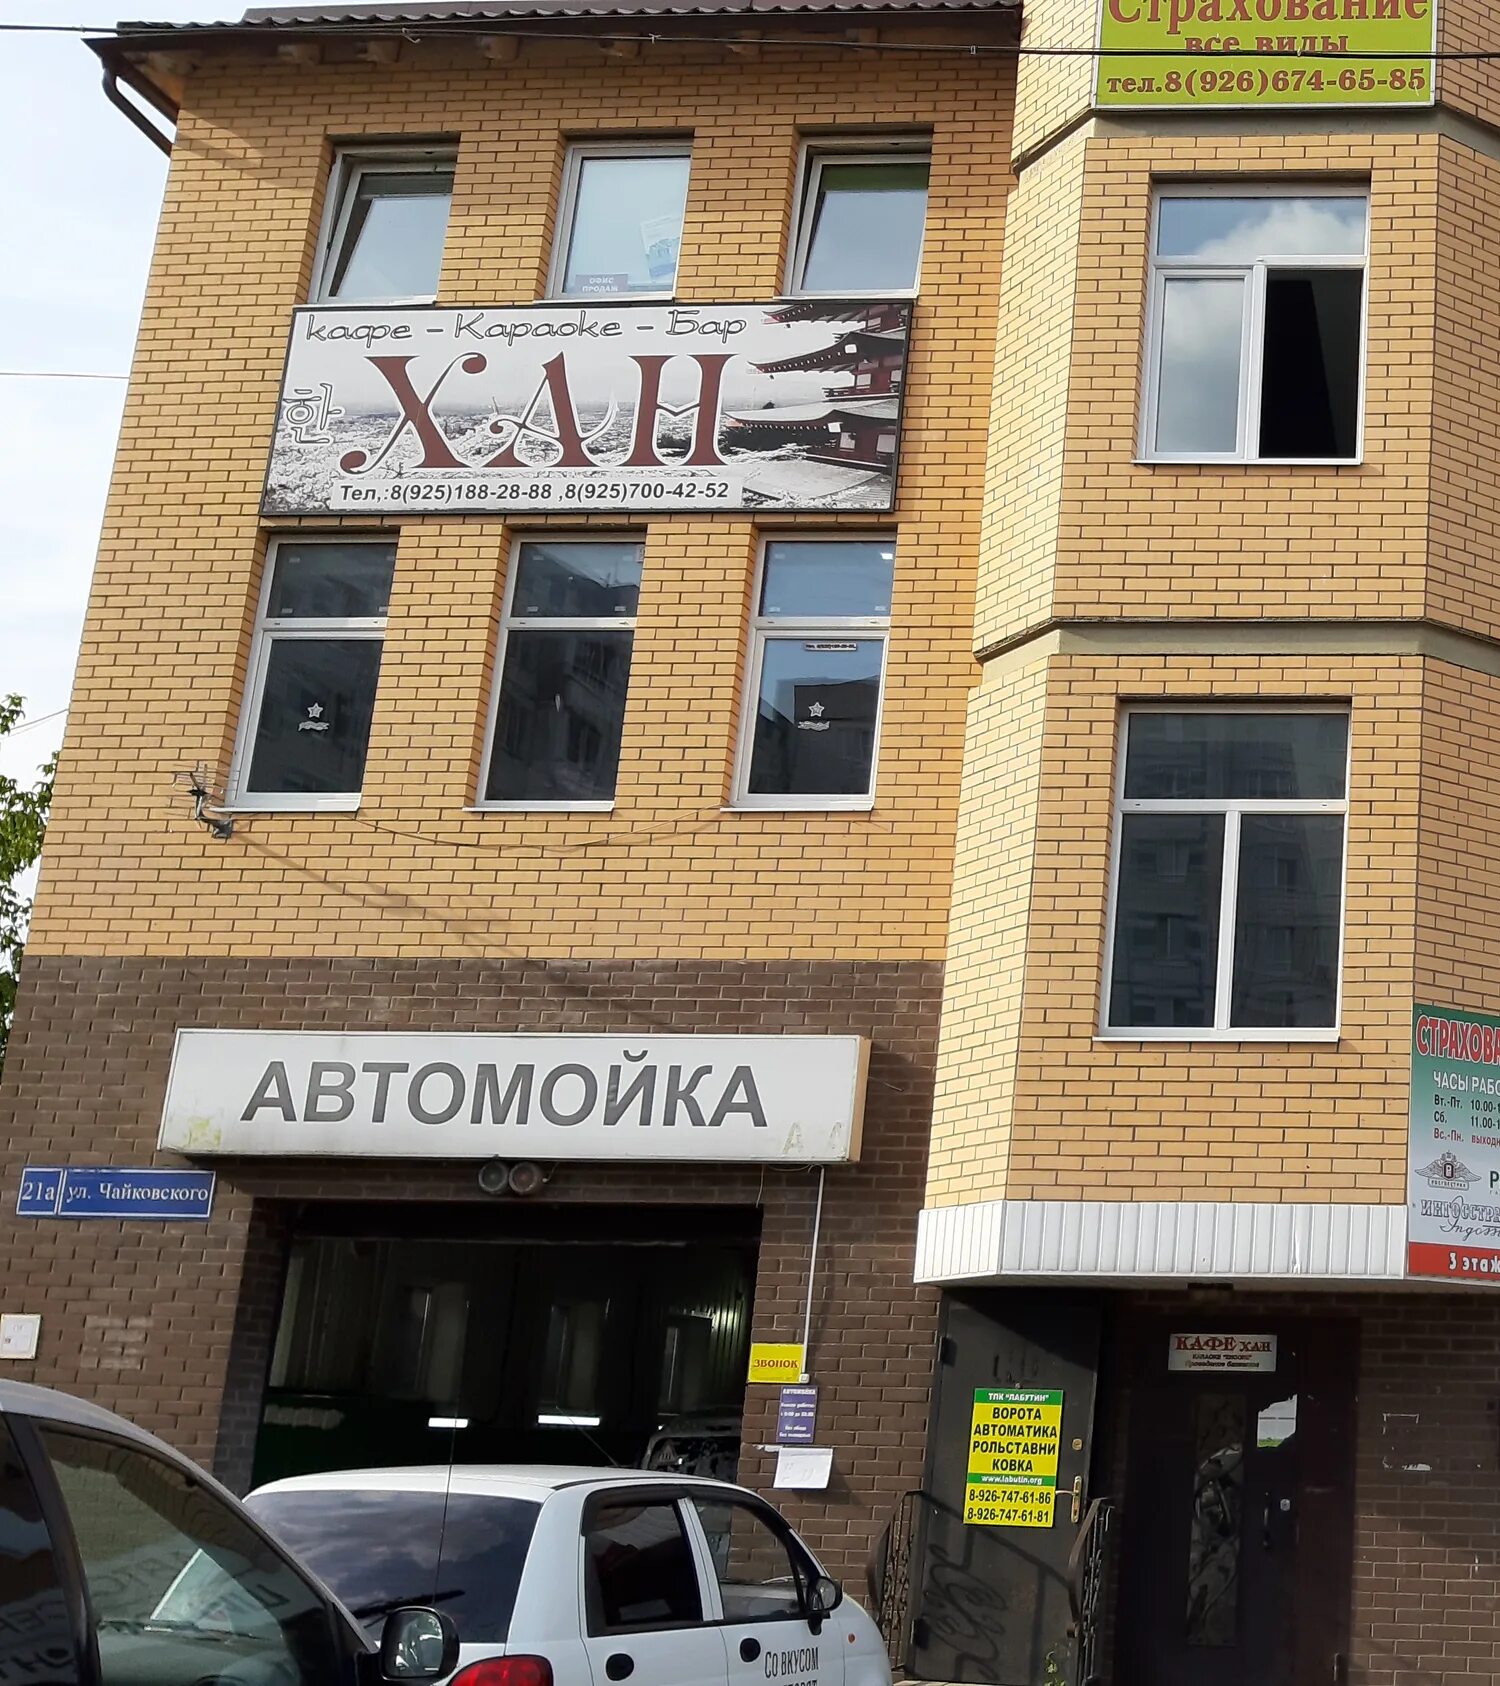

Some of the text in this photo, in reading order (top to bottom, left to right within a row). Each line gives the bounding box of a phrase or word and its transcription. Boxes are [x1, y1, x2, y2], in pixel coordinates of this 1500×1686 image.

[1184, 35, 1349, 52] все виды
[1106, 67, 1426, 97] тел.8(926)674-65-85
[665, 309, 748, 344] Бар
[338, 351, 740, 474] ХАН
[240, 1049, 768, 1128] АВТОМОЙКА
[1433, 1071, 1469, 1093] ЧАСЫ
[21, 1182, 209, 1203] 21а ул. Чайковского
[1449, 1252, 1457, 1270] 3
[1175, 1335, 1238, 1352] КАФЕ
[753, 1358, 799, 1369] ЗВОНОК
[988, 1392, 1004, 1401] ТПК
[992, 1407, 1042, 1421] ВОРОТА
[973, 1423, 1058, 1438] АВТОМАТИКА
[972, 1440, 1056, 1456] РОЛЬСТАВНИ
[992, 1459, 1034, 1472] КОВКА
[969, 1488, 1051, 1504] 8-926-747-61-86
[967, 1507, 1050, 1523] 8-926-747-61-81
[765, 1646, 819, 1678] СО ВКУСОМ
